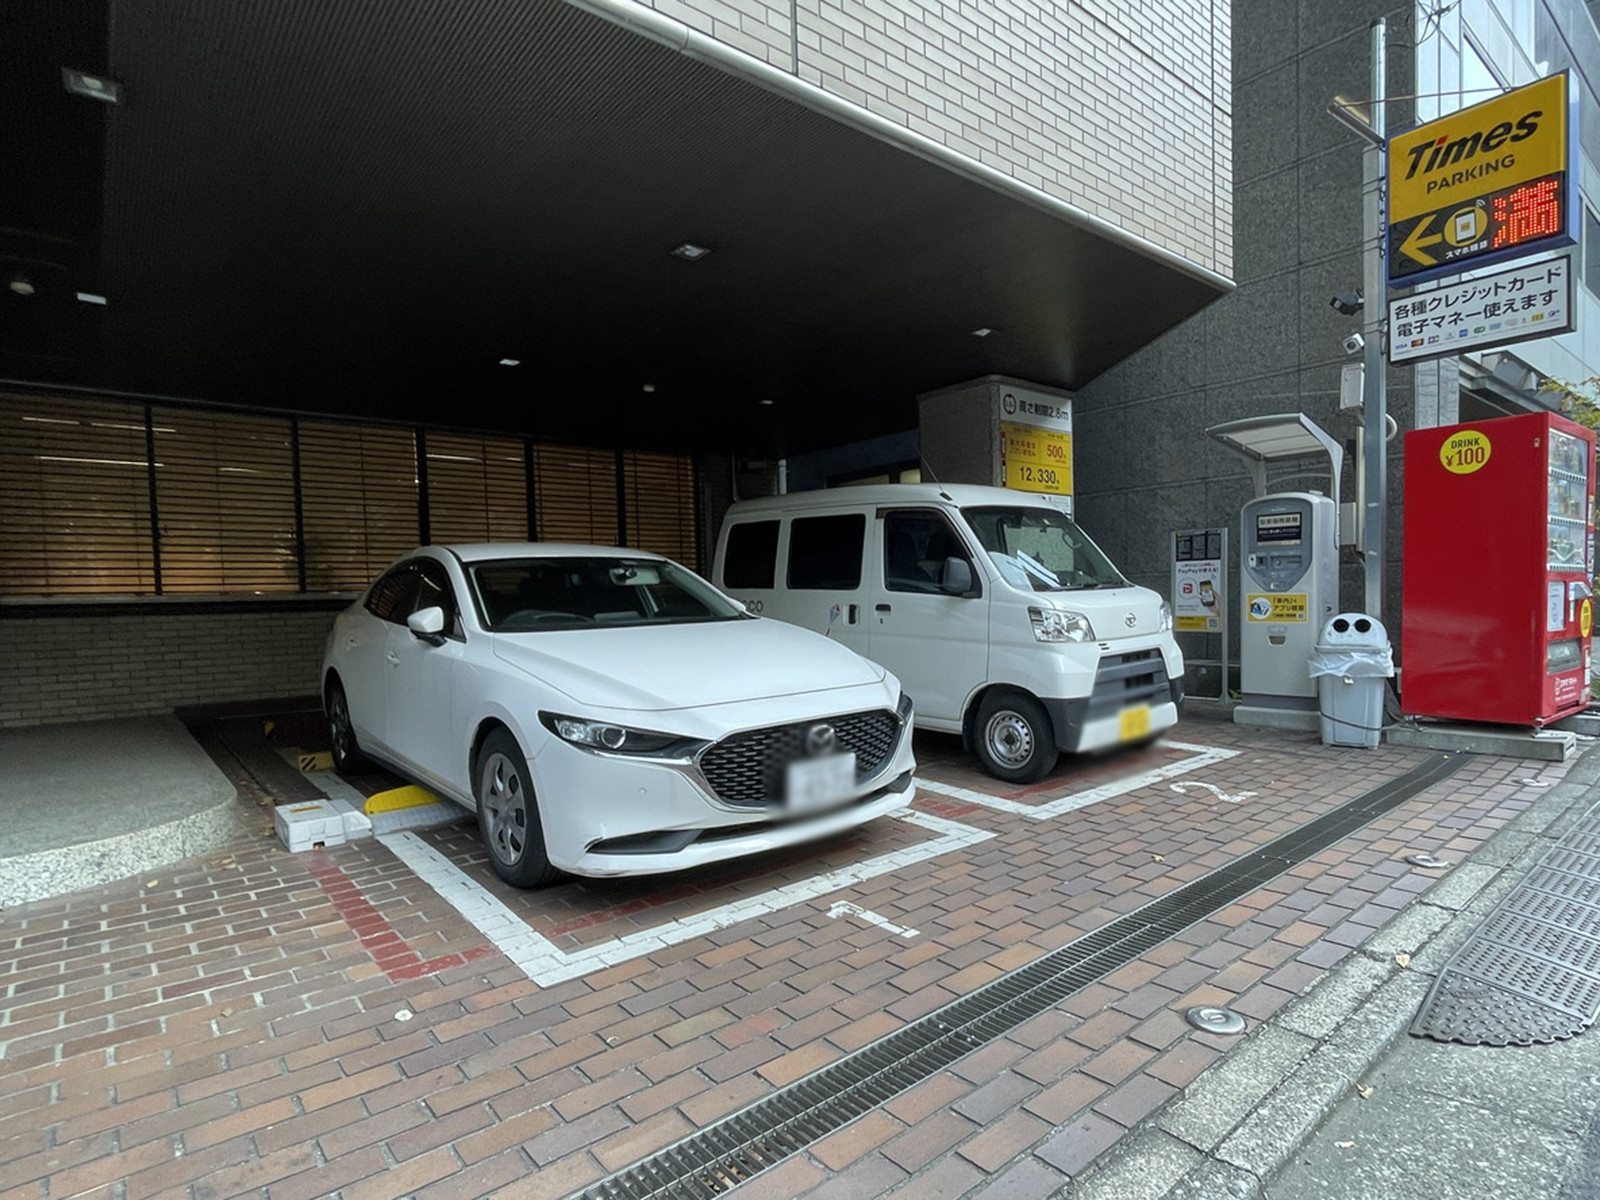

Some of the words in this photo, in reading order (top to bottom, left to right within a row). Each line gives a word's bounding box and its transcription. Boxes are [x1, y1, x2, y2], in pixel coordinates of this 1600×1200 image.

[1405, 110, 1543, 180] Times
[1426, 154, 1516, 194] PARKING
[1493, 180, 1558, 248] 満
[1394, 265, 1562, 321] 各種クレジットカード
[1397, 289, 1558, 338] 電子マネー使えます
[1450, 437, 1480, 449] DRINK
[1169, 780, 1258, 802] 2
